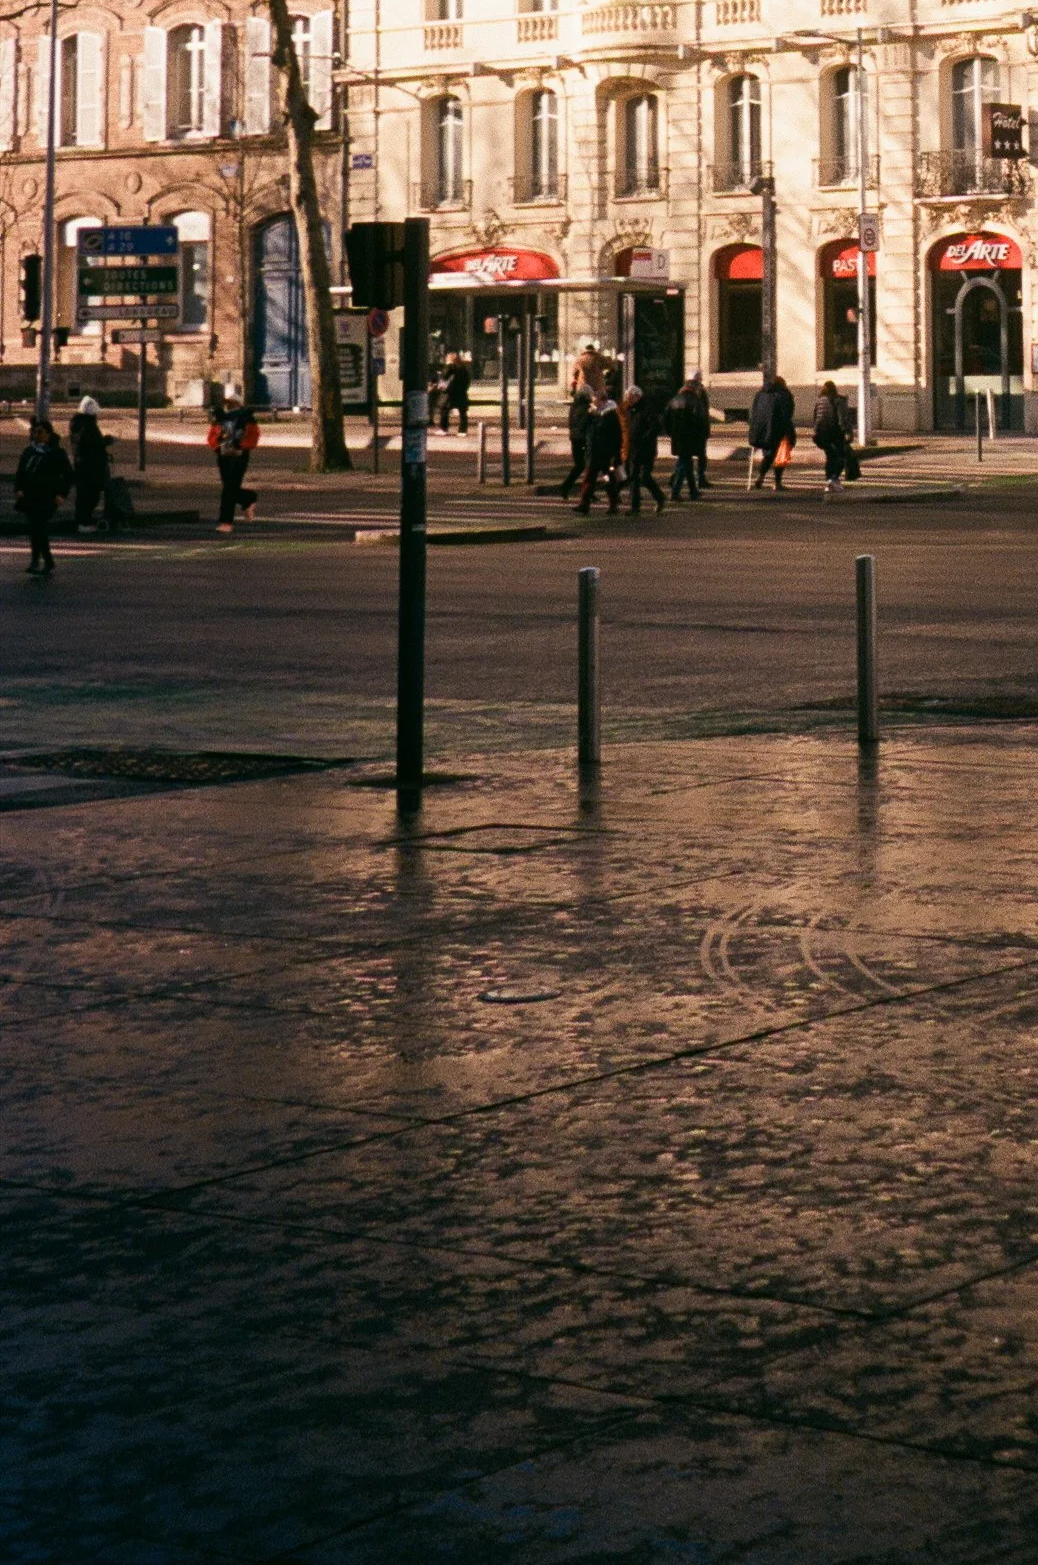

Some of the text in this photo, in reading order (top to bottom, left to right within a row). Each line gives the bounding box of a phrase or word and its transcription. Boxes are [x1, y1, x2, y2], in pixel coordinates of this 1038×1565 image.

[945, 239, 1011, 267] DEL ARTE
[474, 254, 518, 279] ARTE
